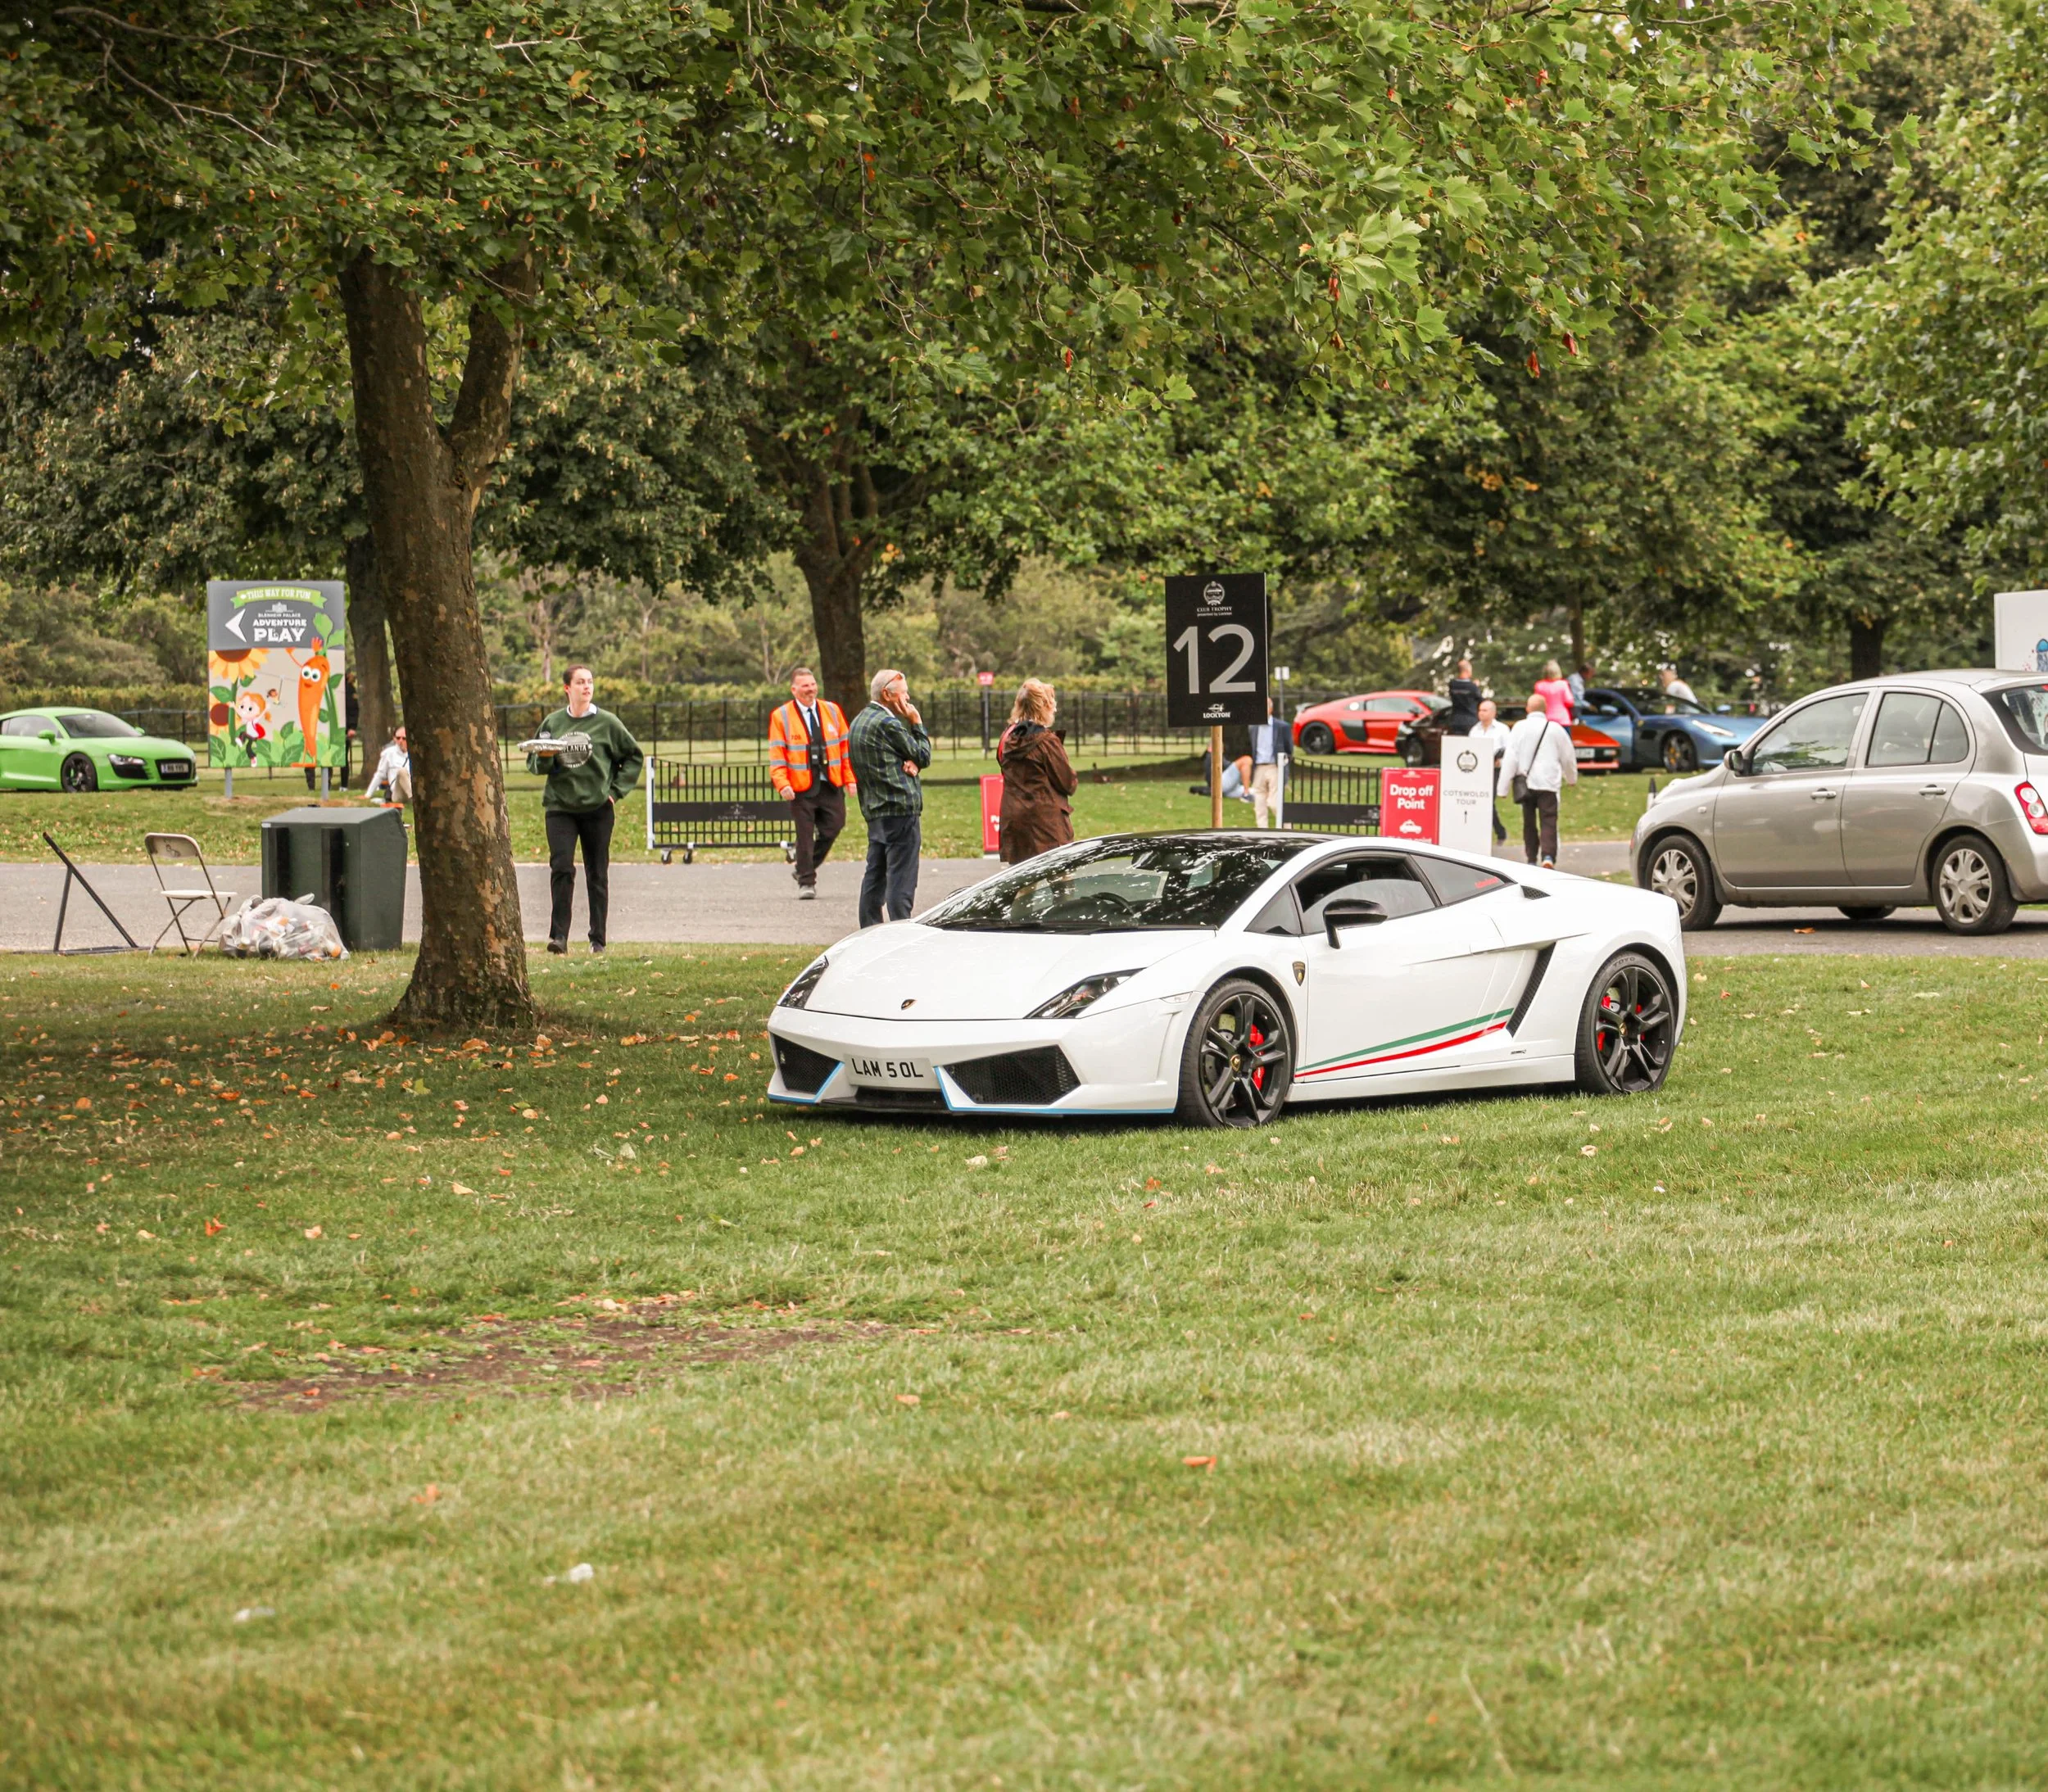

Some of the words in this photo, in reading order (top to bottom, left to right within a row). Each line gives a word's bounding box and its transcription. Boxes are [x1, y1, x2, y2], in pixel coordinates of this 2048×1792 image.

[246, 590, 264, 600] THIS
[265, 588, 279, 597] WAY
[281, 588, 294, 598] FOR
[296, 590, 311, 600] FUN
[252, 618, 307, 627] ADVENTURE
[253, 627, 306, 642] PLAY
[1172, 623, 1257, 695] 12
[1389, 784, 1416, 798] Drop
[1418, 785, 1434, 796] off
[1443, 790, 1490, 799] COTSWOLDS
[1397, 798, 1425, 810] Point
[1612, 956, 1636, 966] TOYO
[851, 1057, 882, 1077] LAM
